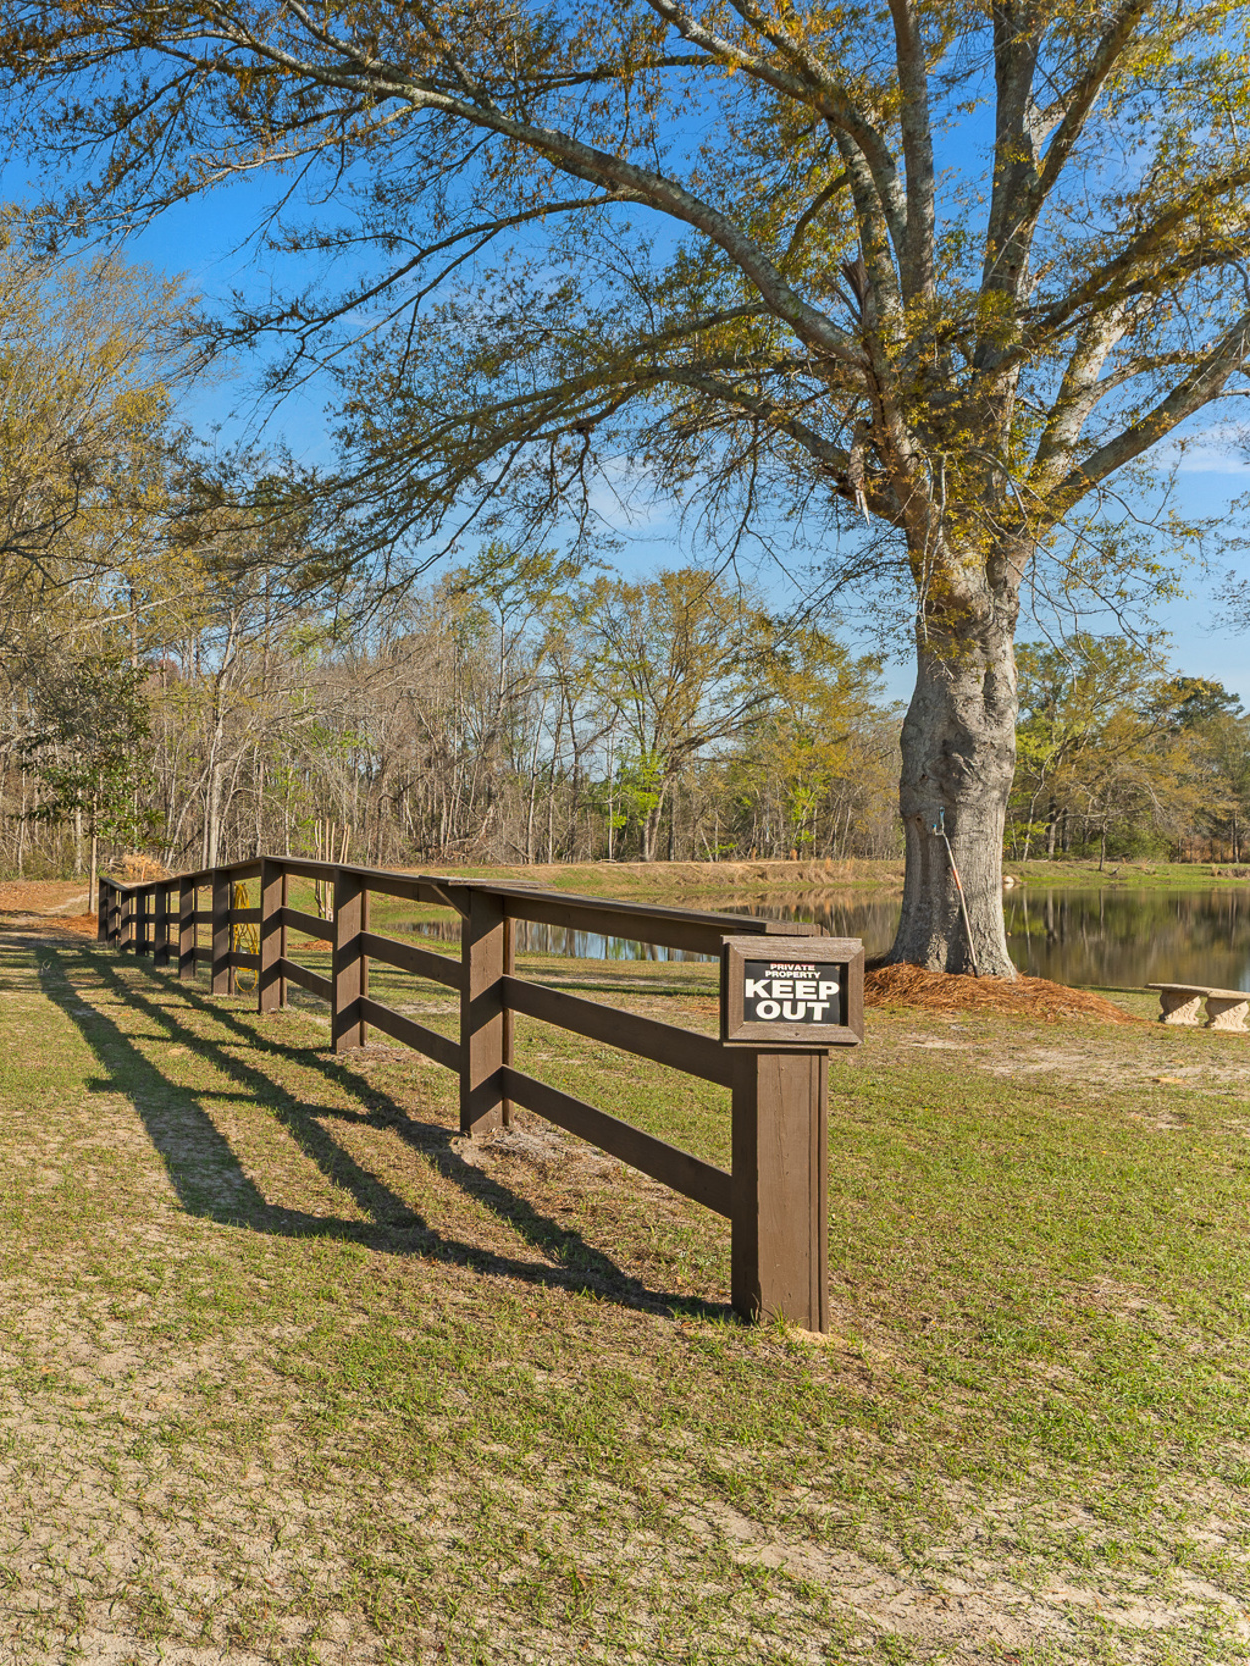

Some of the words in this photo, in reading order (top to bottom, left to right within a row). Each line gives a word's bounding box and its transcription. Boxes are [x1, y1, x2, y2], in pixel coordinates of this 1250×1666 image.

[770, 963, 815, 971] PRIVATE
[765, 971, 821, 979] PROPERTY
[745, 979, 840, 1000] KEEP
[756, 1000, 830, 1021] OUT
